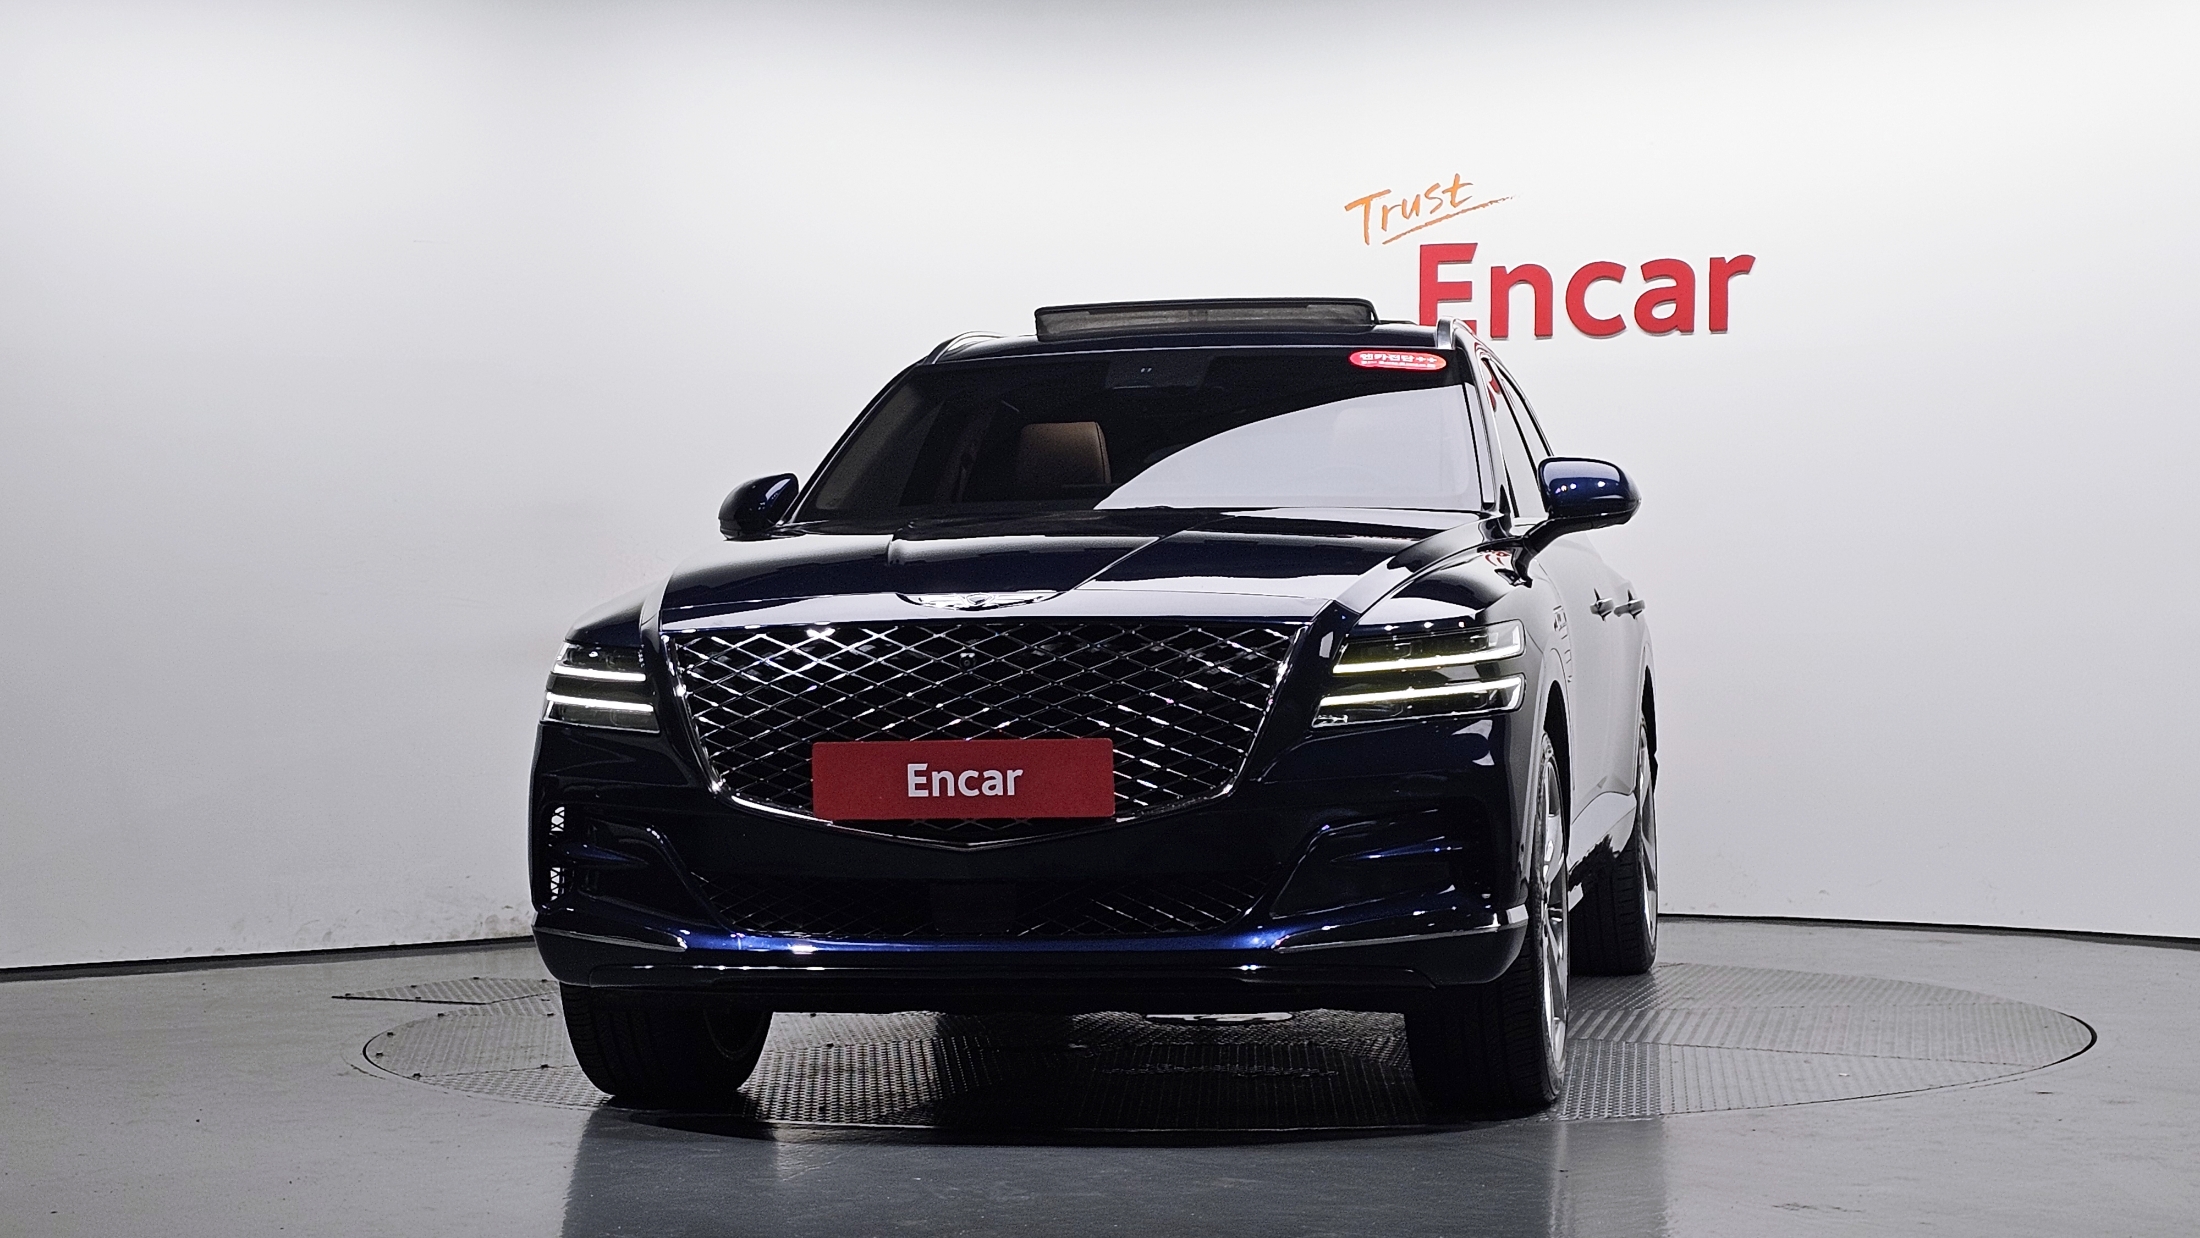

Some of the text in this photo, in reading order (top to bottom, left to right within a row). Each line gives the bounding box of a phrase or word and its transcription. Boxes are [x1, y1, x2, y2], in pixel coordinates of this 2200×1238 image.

[1344, 173, 1474, 245] Trust
[1419, 242, 1756, 338] Encar
[907, 763, 1023, 797] Encar
